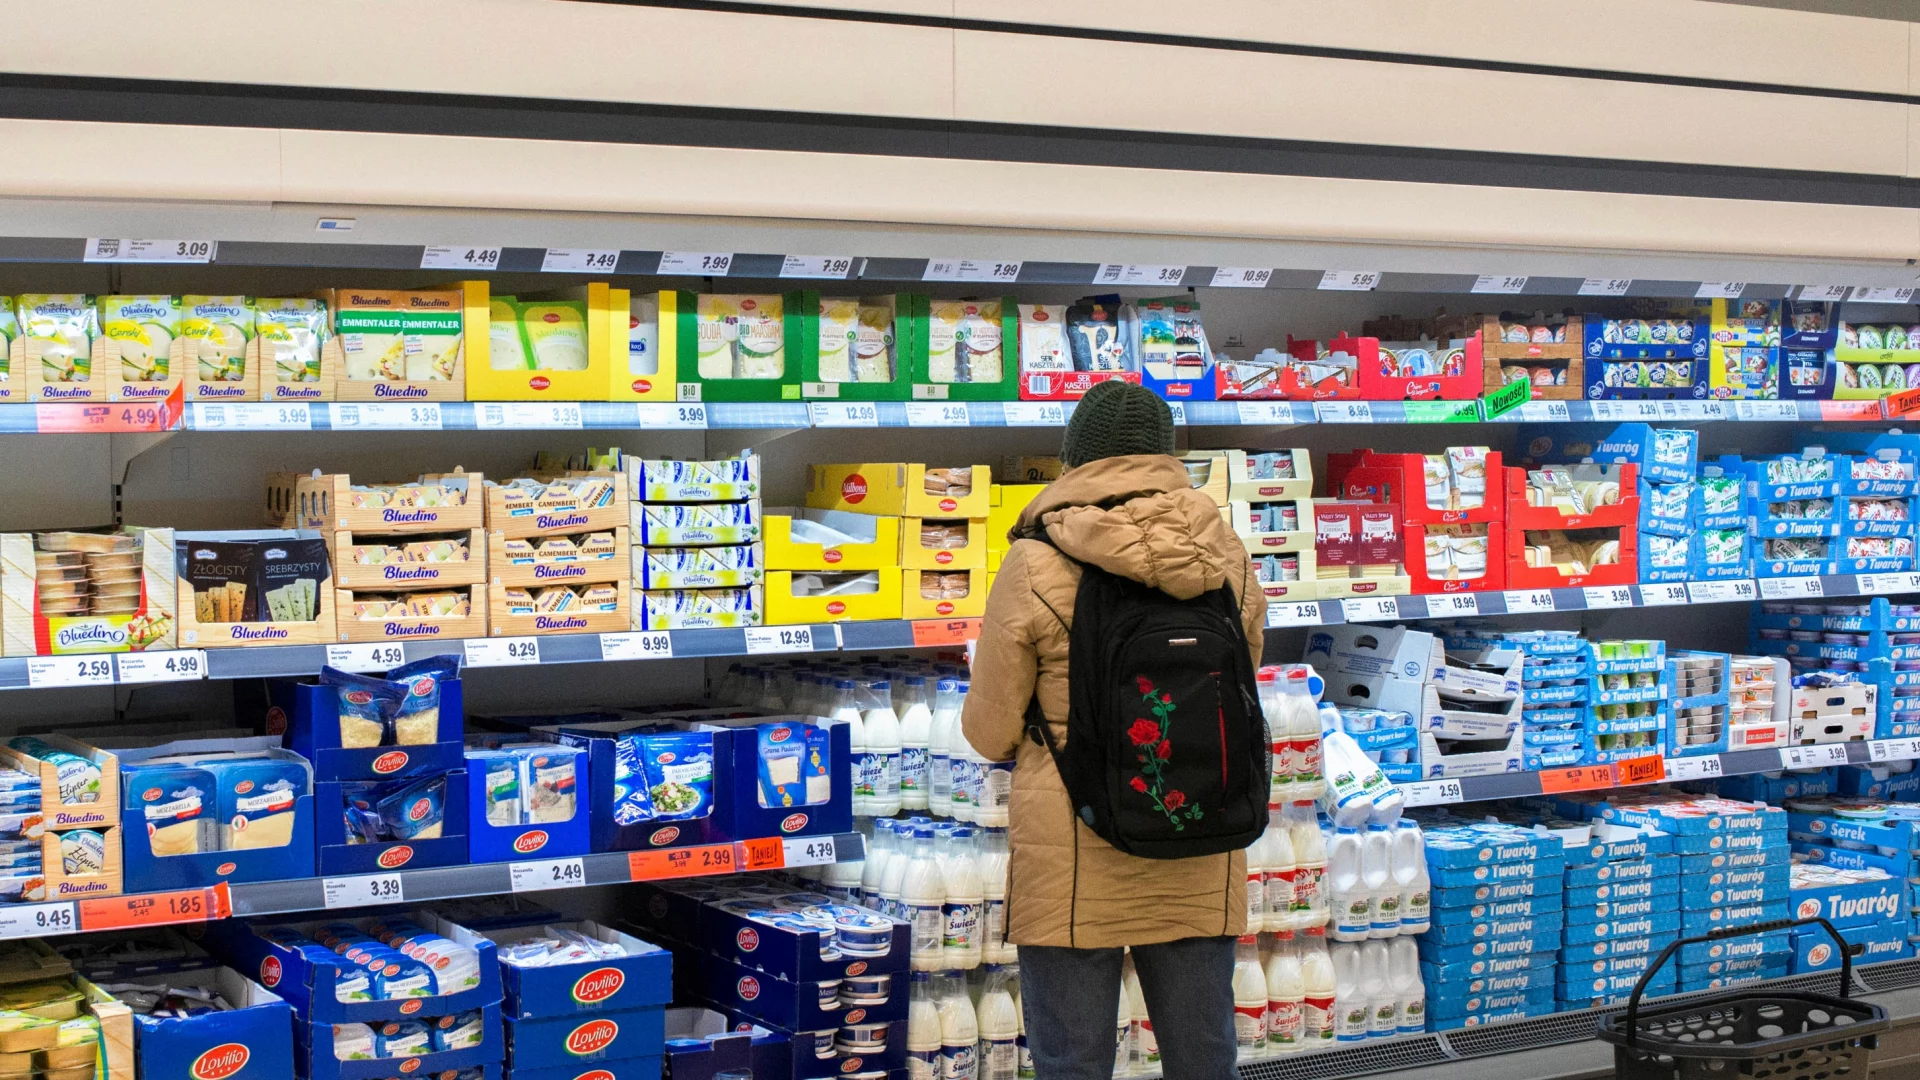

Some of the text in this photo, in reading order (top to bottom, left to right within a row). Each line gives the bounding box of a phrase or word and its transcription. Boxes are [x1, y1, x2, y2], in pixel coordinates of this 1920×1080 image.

[177, 243, 208, 256] 3.09
[464, 250, 498, 263] 4.49
[586, 254, 616, 267] 7.49
[702, 256, 729, 269] 7.99
[822, 260, 848, 272] 7.99
[993, 264, 1017, 276] 7.99
[1158, 268, 1182, 280] 3.99
[1243, 271, 1269, 282] 10.99
[1352, 274, 1373, 285] 5.95
[1503, 277, 1525, 288] 7.49
[1607, 280, 1629, 291] 5.49
[1724, 282, 1743, 293] 4.39
[1826, 285, 1844, 296] 2.99
[1895, 288, 1912, 298] 6.99
[351, 296, 391, 306] Bluedino
[410, 297, 450, 308] Bluedino
[342, 318, 401, 328] EMMENTALER
[402, 320, 459, 329] EMMENTALER
[1077, 375, 1090, 383] SER
[43, 387, 92, 398] Bluedino
[122, 386, 170, 398] Bluedino
[198, 385, 245, 397] Bluedino
[276, 386, 321, 398] Bluedino
[374, 384, 428, 398] Bluedino
[121, 408, 155, 424] 4.99
[279, 409, 307, 422] 3.99
[411, 408, 438, 422] 3.39
[552, 408, 579, 422] 3.39
[679, 408, 704, 422] 3.99
[846, 408, 874, 420] 12.99
[943, 408, 966, 420] 2.99
[1040, 408, 1061, 420] 2.99
[1270, 406, 1291, 418] 7.99
[1349, 406, 1369, 417] 8.99
[1548, 404, 1566, 415] 9.99
[1638, 404, 1656, 415] 2.29
[1702, 404, 1721, 415] 2.49
[1780, 405, 1796, 415] 2.89
[1597, 441, 1639, 456] Twaróg
[1662, 467, 1688, 479] Twaróg
[842, 483, 867, 495] Milbona
[1790, 484, 1824, 497] Twaróg
[1871, 480, 1906, 494] Twaróg
[538, 500, 576, 510] CAMEMBERT
[383, 509, 437, 523] Bluedino
[536, 514, 588, 529] Bluedino
[1713, 516, 1740, 528] Twaróg
[1659, 520, 1686, 533] Twaróg
[1790, 523, 1823, 535] Twaróg
[1869, 520, 1900, 535] Twaróg
[539, 549, 577, 558] CAMEMBERT
[194, 564, 247, 575] ZŁOCISTY
[265, 562, 321, 574] SREBRZYSTY
[1787, 561, 1821, 574] Twaróg
[1869, 557, 1903, 570] Twaróg
[384, 567, 439, 579] Bluedino
[534, 566, 586, 579] Bluedino
[1660, 571, 1688, 580] Twaróg
[1718, 566, 1743, 577] Twaróg
[1667, 587, 1684, 599] 3.99
[1735, 584, 1752, 595] 3.99
[1805, 581, 1820, 592] 1.59
[1530, 594, 1552, 606] 4.49
[1612, 590, 1630, 602] 3.99
[1378, 601, 1395, 614] 1.59
[1452, 597, 1475, 609] 13.99
[1296, 606, 1317, 618] 2.59
[385, 623, 440, 637] Bluedino
[536, 617, 587, 630] Bluedino
[1823, 617, 1862, 631] Wiejski
[58, 627, 124, 646] Bluedino
[231, 626, 288, 639] Bluedino
[779, 630, 810, 645] 12.99
[642, 636, 669, 650] 9.99
[372, 648, 401, 663] 4.59
[508, 643, 536, 657] 9.29
[1820, 647, 1858, 660] Wiejski
[78, 661, 109, 676] 2.59
[165, 657, 198, 672] 4.99
[1609, 658, 1656, 672] Twaróg kozi
[1612, 688, 1658, 702] Twaróg kozi
[1609, 719, 1656, 732] Twaróg kozi
[377, 753, 406, 768] Lovilio
[1828, 748, 1845, 760] 3.99
[1629, 762, 1658, 779] TANIEJ!
[1702, 759, 1719, 772] 2.79
[1592, 769, 1609, 782] 1.79
[1439, 784, 1460, 797] 2.59
[56, 813, 105, 824] Bluedino
[1725, 816, 1762, 830] Twaróg
[1830, 823, 1865, 841] Serek
[515, 832, 547, 850] Lovilio
[806, 843, 832, 858] 4.79
[1496, 844, 1537, 858] Twaróg
[1608, 842, 1646, 857] Twaróg
[379, 847, 411, 866] Lovilio
[702, 850, 730, 866] 2.99
[552, 864, 581, 880] 2.49
[1492, 864, 1534, 877] Twaróg
[1614, 864, 1652, 878] Twaróg
[59, 881, 108, 894] Bluedino
[371, 880, 400, 896] 3.39
[1494, 883, 1533, 897] Twaróg
[169, 896, 201, 914] 1.85
[1829, 887, 1900, 921] Twaróg
[36, 909, 71, 926] 9.45
[949, 917, 977, 930] Świeże
[1612, 920, 1651, 934] Twaróg
[1868, 937, 1902, 954] Twaróg
[579, 972, 619, 997] Lovilio
[573, 1022, 613, 1048] Lovilio
[199, 1049, 244, 1074] Lovilio
